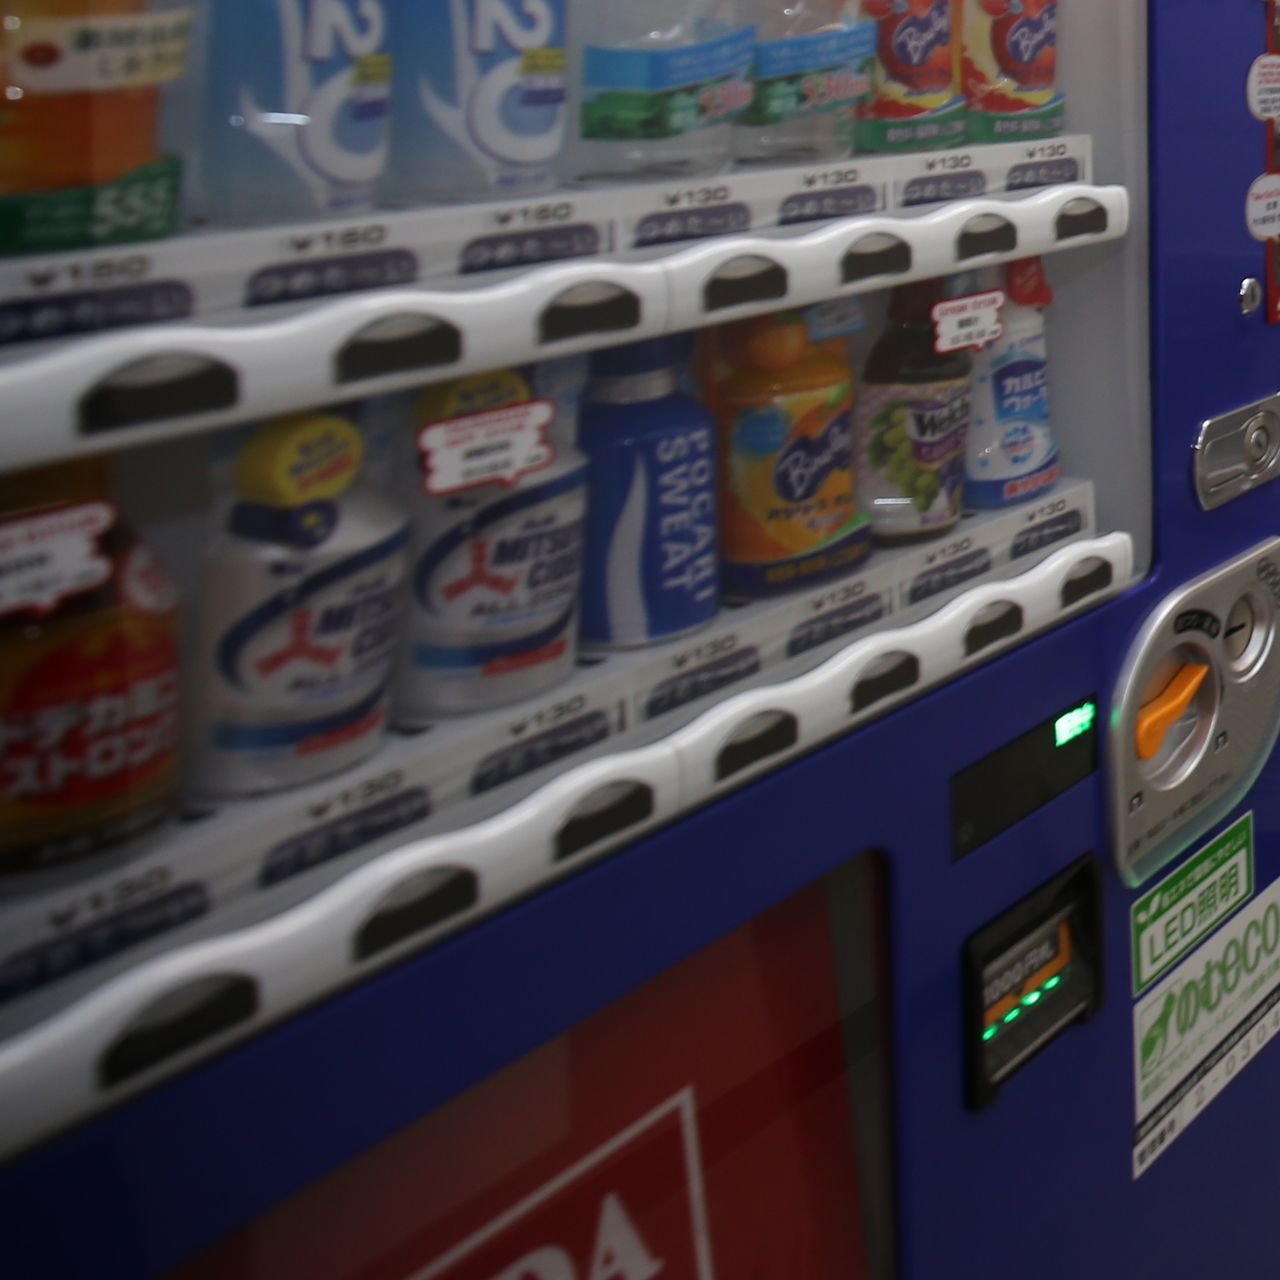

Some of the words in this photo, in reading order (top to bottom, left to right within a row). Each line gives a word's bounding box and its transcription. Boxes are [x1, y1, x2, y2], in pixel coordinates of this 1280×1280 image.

[925, 153, 971, 170] ¥130
[1024, 143, 1068, 159] ¥130
[802, 168, 858, 187] ¥130
[664, 184, 731, 207] ¥130
[657, 438, 694, 590] SWEAT
[694, 427, 713, 603] POCARI
